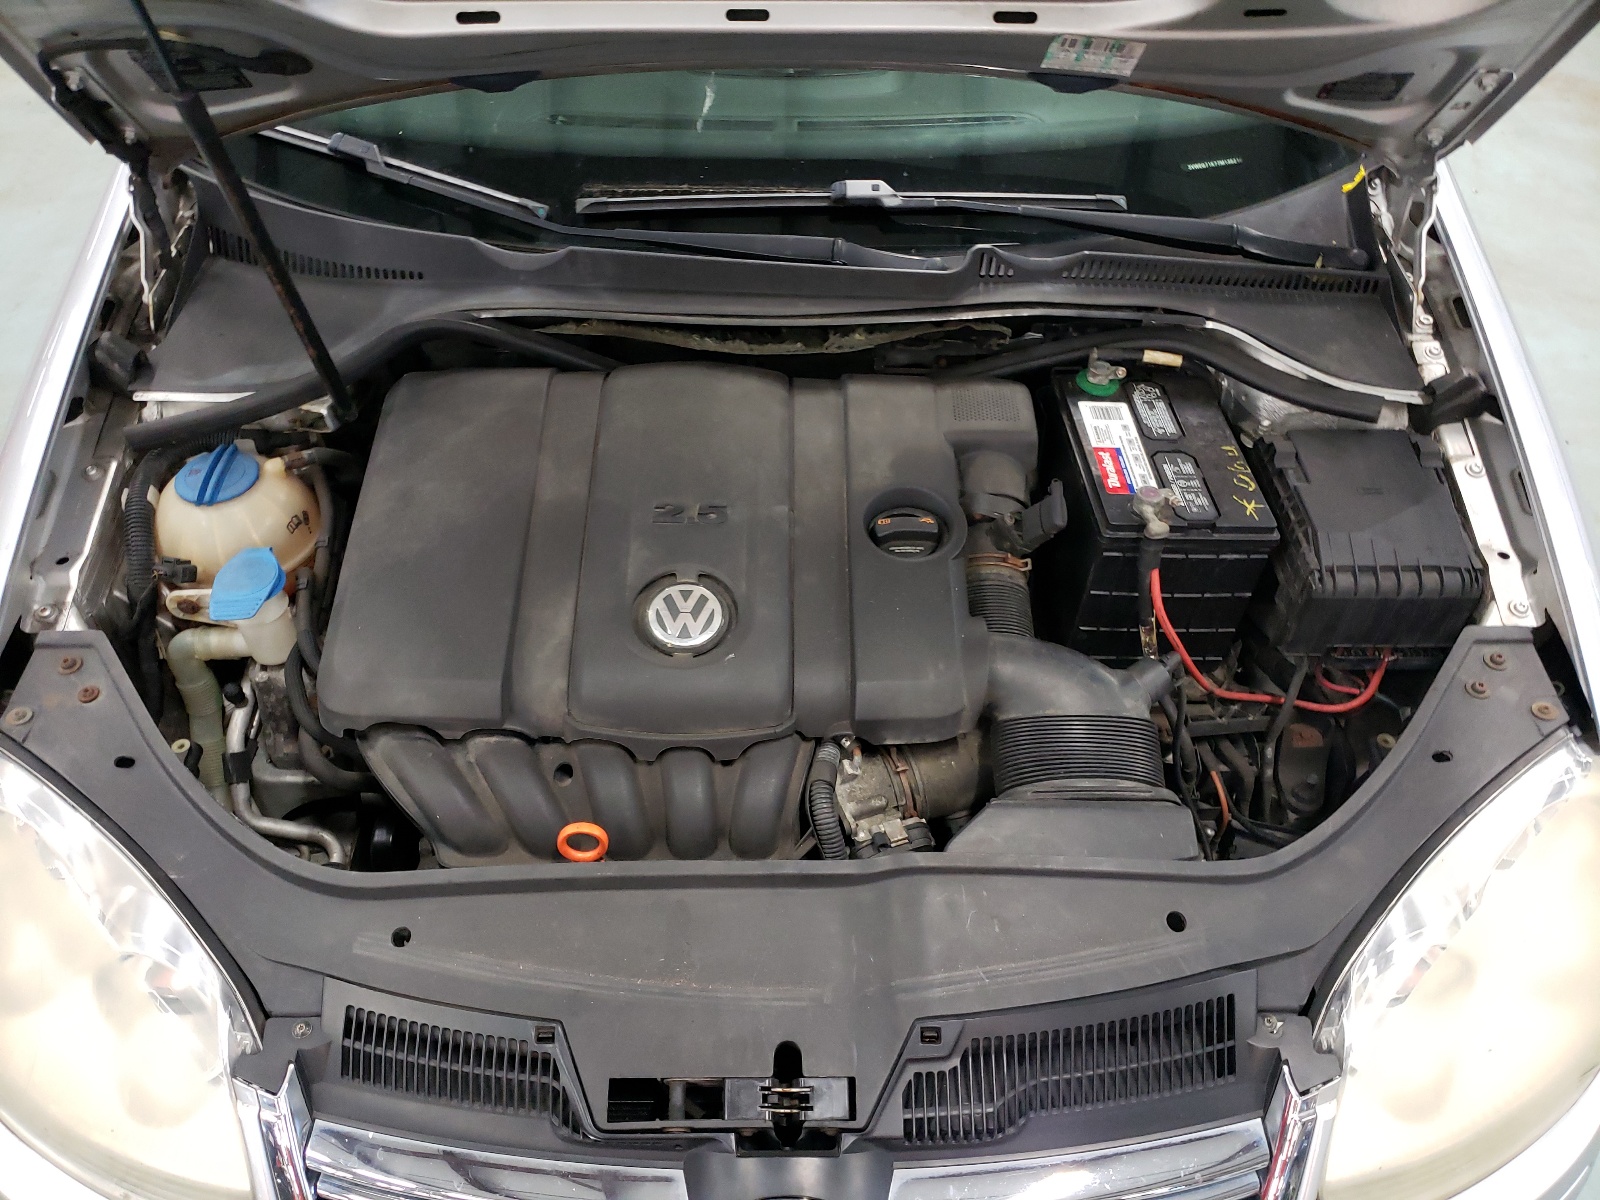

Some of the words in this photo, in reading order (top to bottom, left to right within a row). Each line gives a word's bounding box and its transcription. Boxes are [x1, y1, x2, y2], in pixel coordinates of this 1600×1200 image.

[1098, 451, 1121, 488] Duralast
[652, 503, 728, 525] 2.5
[651, 585, 721, 644] VW
